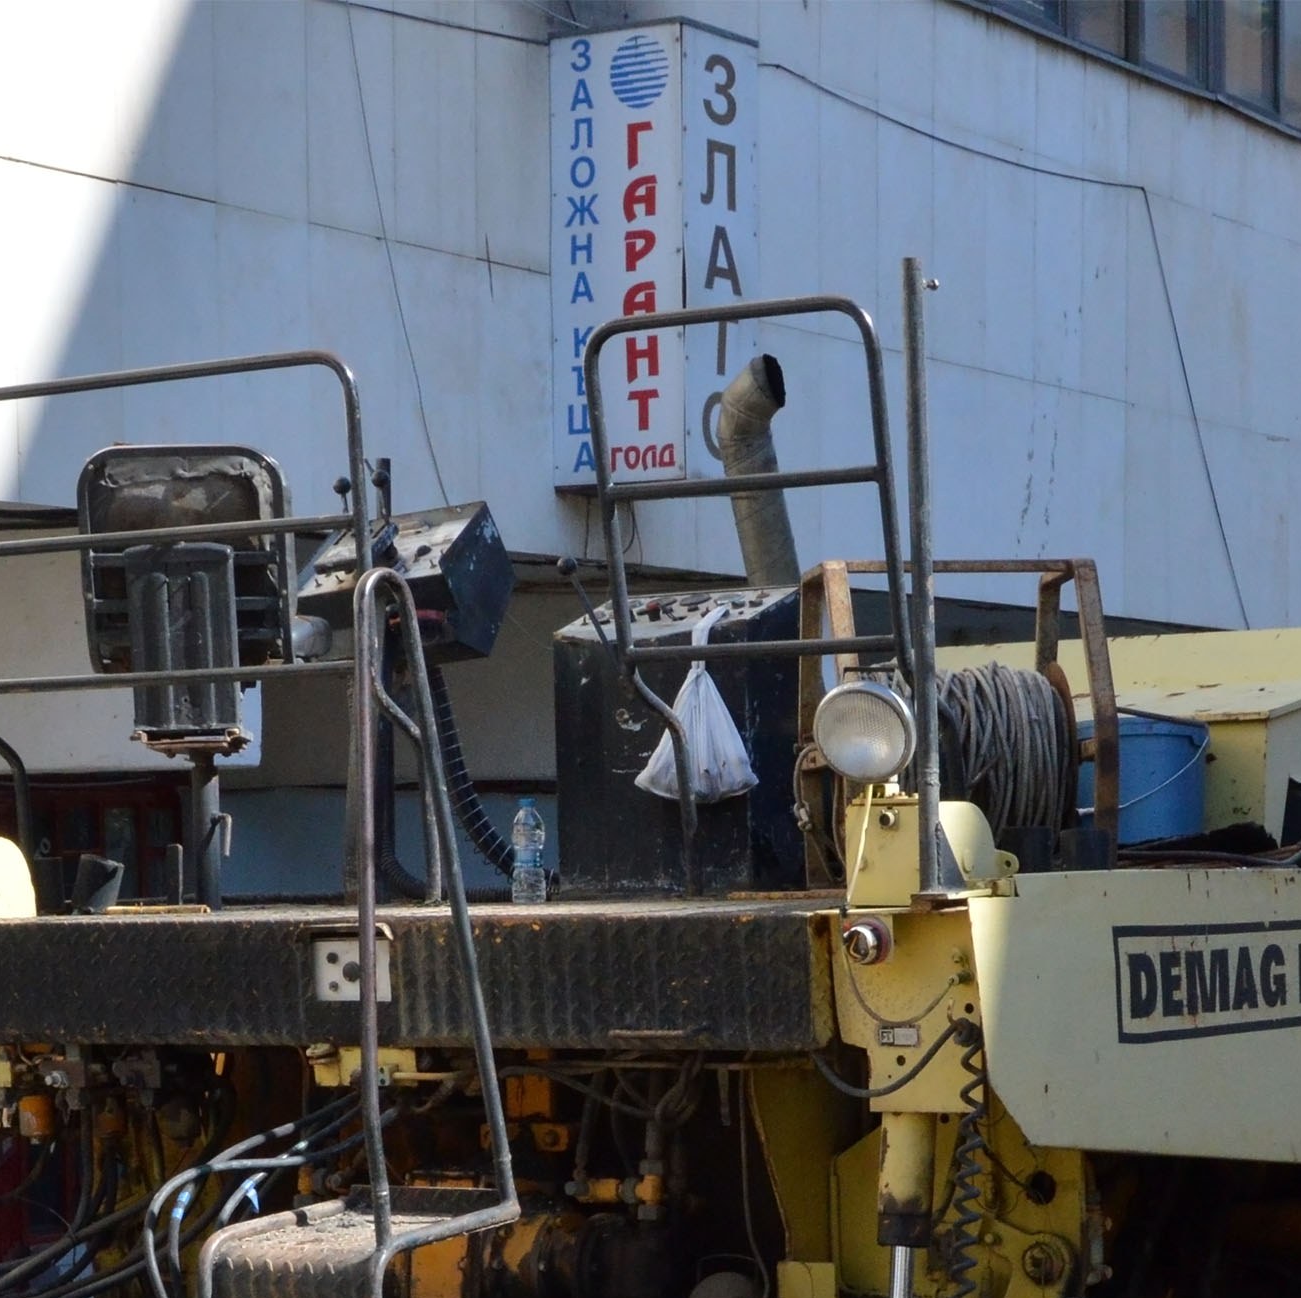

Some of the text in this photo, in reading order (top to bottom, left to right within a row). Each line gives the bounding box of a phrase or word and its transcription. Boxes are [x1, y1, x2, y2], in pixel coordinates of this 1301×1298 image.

[564, 38, 599, 304] ЗАЛОЖНА
[622, 120, 660, 431] ГАРАНТ
[1127, 944, 1287, 1019] DEMAG
